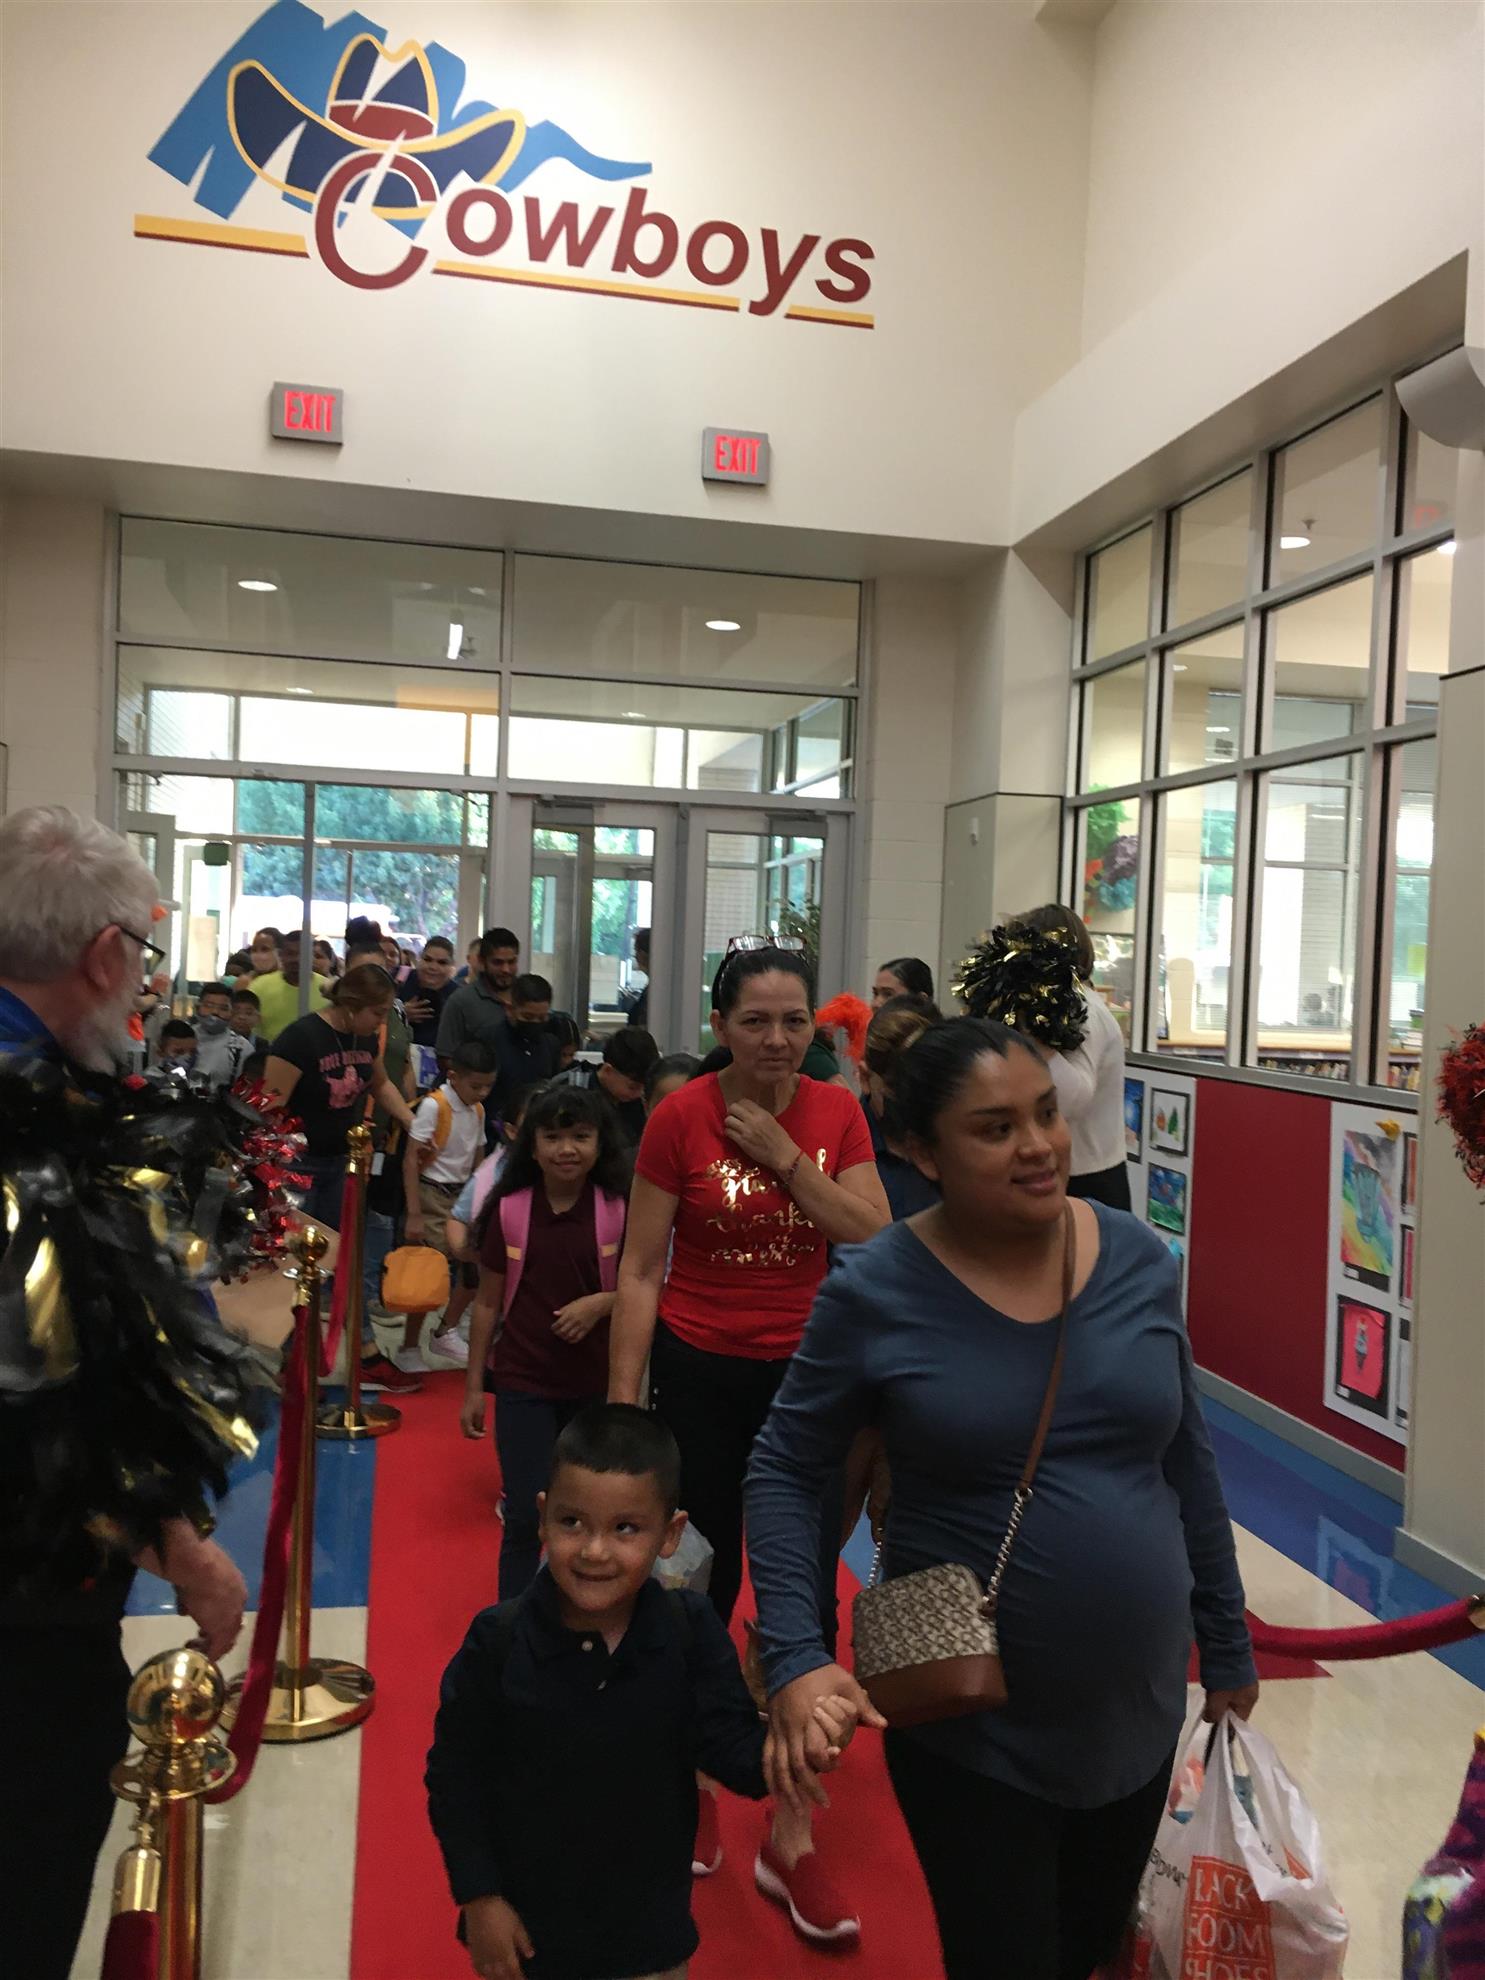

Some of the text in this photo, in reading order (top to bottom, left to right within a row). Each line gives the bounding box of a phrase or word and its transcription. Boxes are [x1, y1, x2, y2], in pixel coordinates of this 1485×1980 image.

[315, 152, 875, 316] Cowboys
[284, 390, 336, 433] EXIT
[714, 434, 761, 475] EXIT
